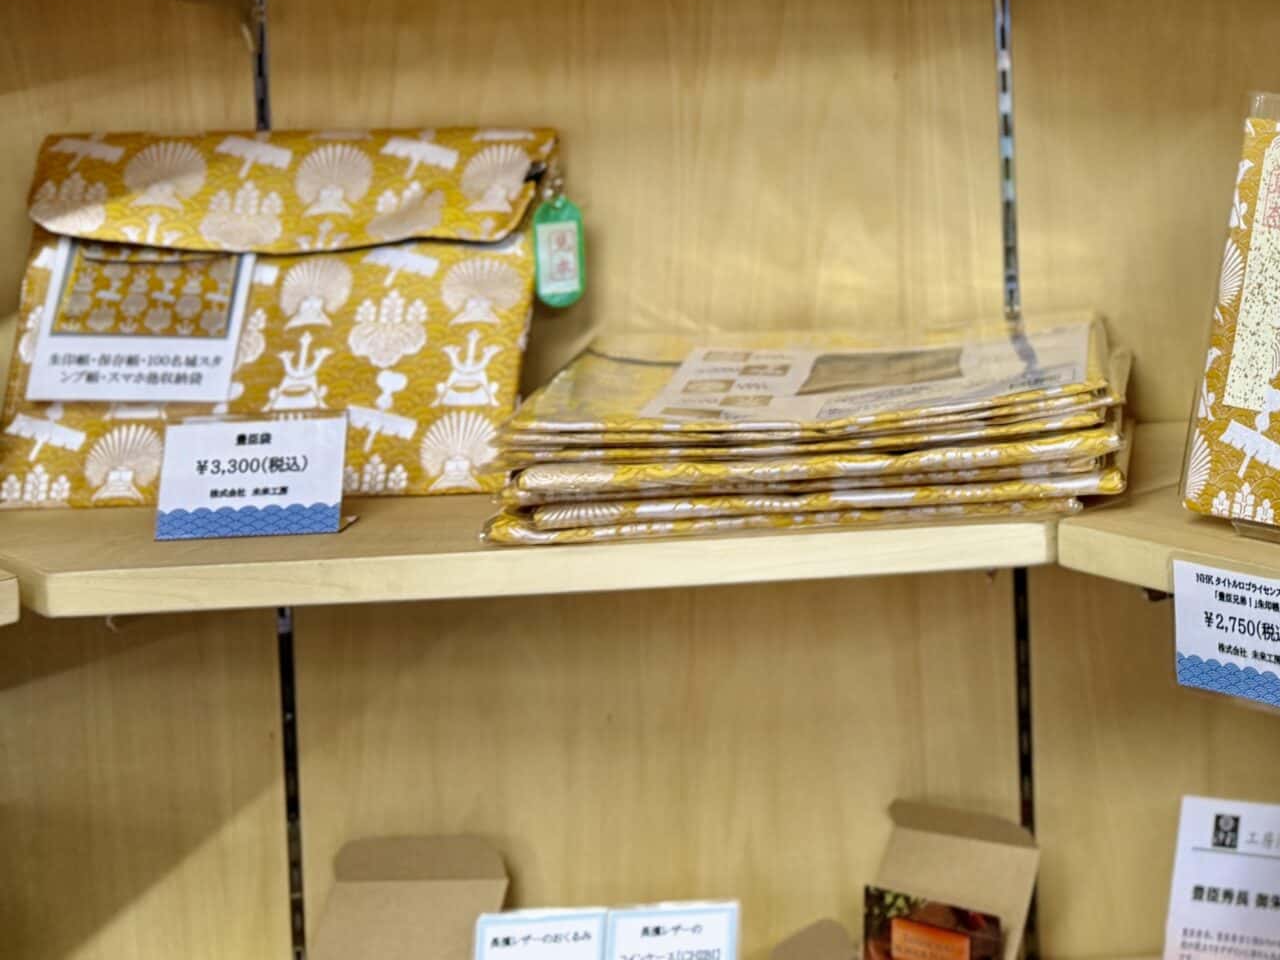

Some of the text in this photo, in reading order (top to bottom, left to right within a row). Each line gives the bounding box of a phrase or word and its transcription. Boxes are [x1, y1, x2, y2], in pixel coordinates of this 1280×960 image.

[196, 455, 309, 476] ¥3,300(税込)
[209, 487, 246, 498] 株式会社
[1217, 642, 1248, 659] 株式会社
[1192, 884, 1250, 907] 豊臣秀長
